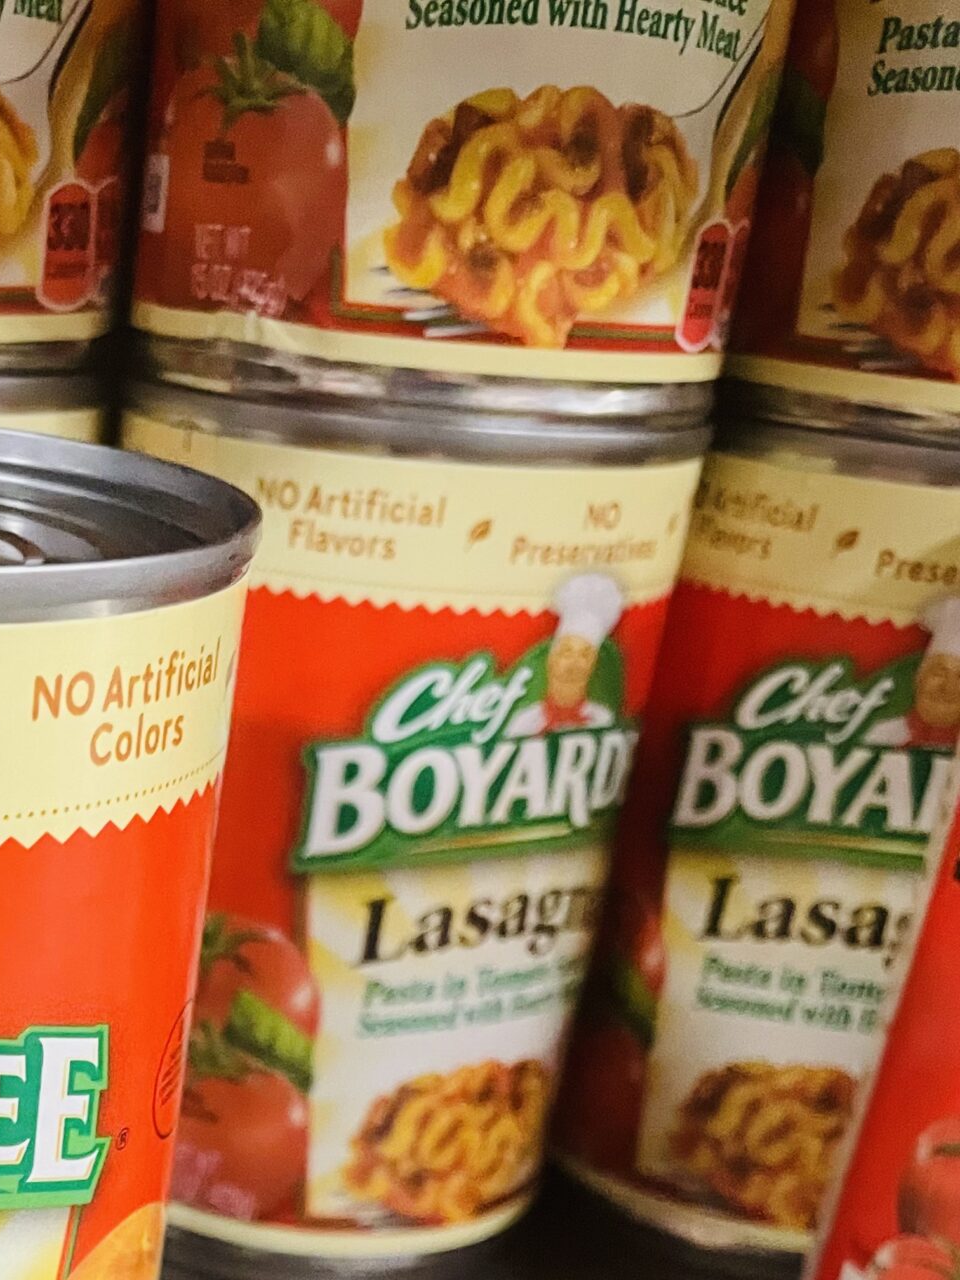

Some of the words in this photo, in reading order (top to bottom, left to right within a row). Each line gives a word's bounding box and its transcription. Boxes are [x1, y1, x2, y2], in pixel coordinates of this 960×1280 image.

[406, 0, 538, 29] Seasoned
[549, 0, 606, 29] with
[614, 0, 695, 55] Hearty
[696, 10, 741, 62] Meat
[875, 14, 960, 54] Pasta
[867, 59, 960, 97] Season
[256, 476, 302, 511] NO
[306, 481, 447, 528] Artificial
[288, 518, 397, 562] Flavors
[32, 669, 97, 722] NO
[102, 635, 222, 713] Artificial
[371, 656, 534, 744] Chef
[735, 663, 896, 746] Chef
[88, 712, 185, 767] Colors
